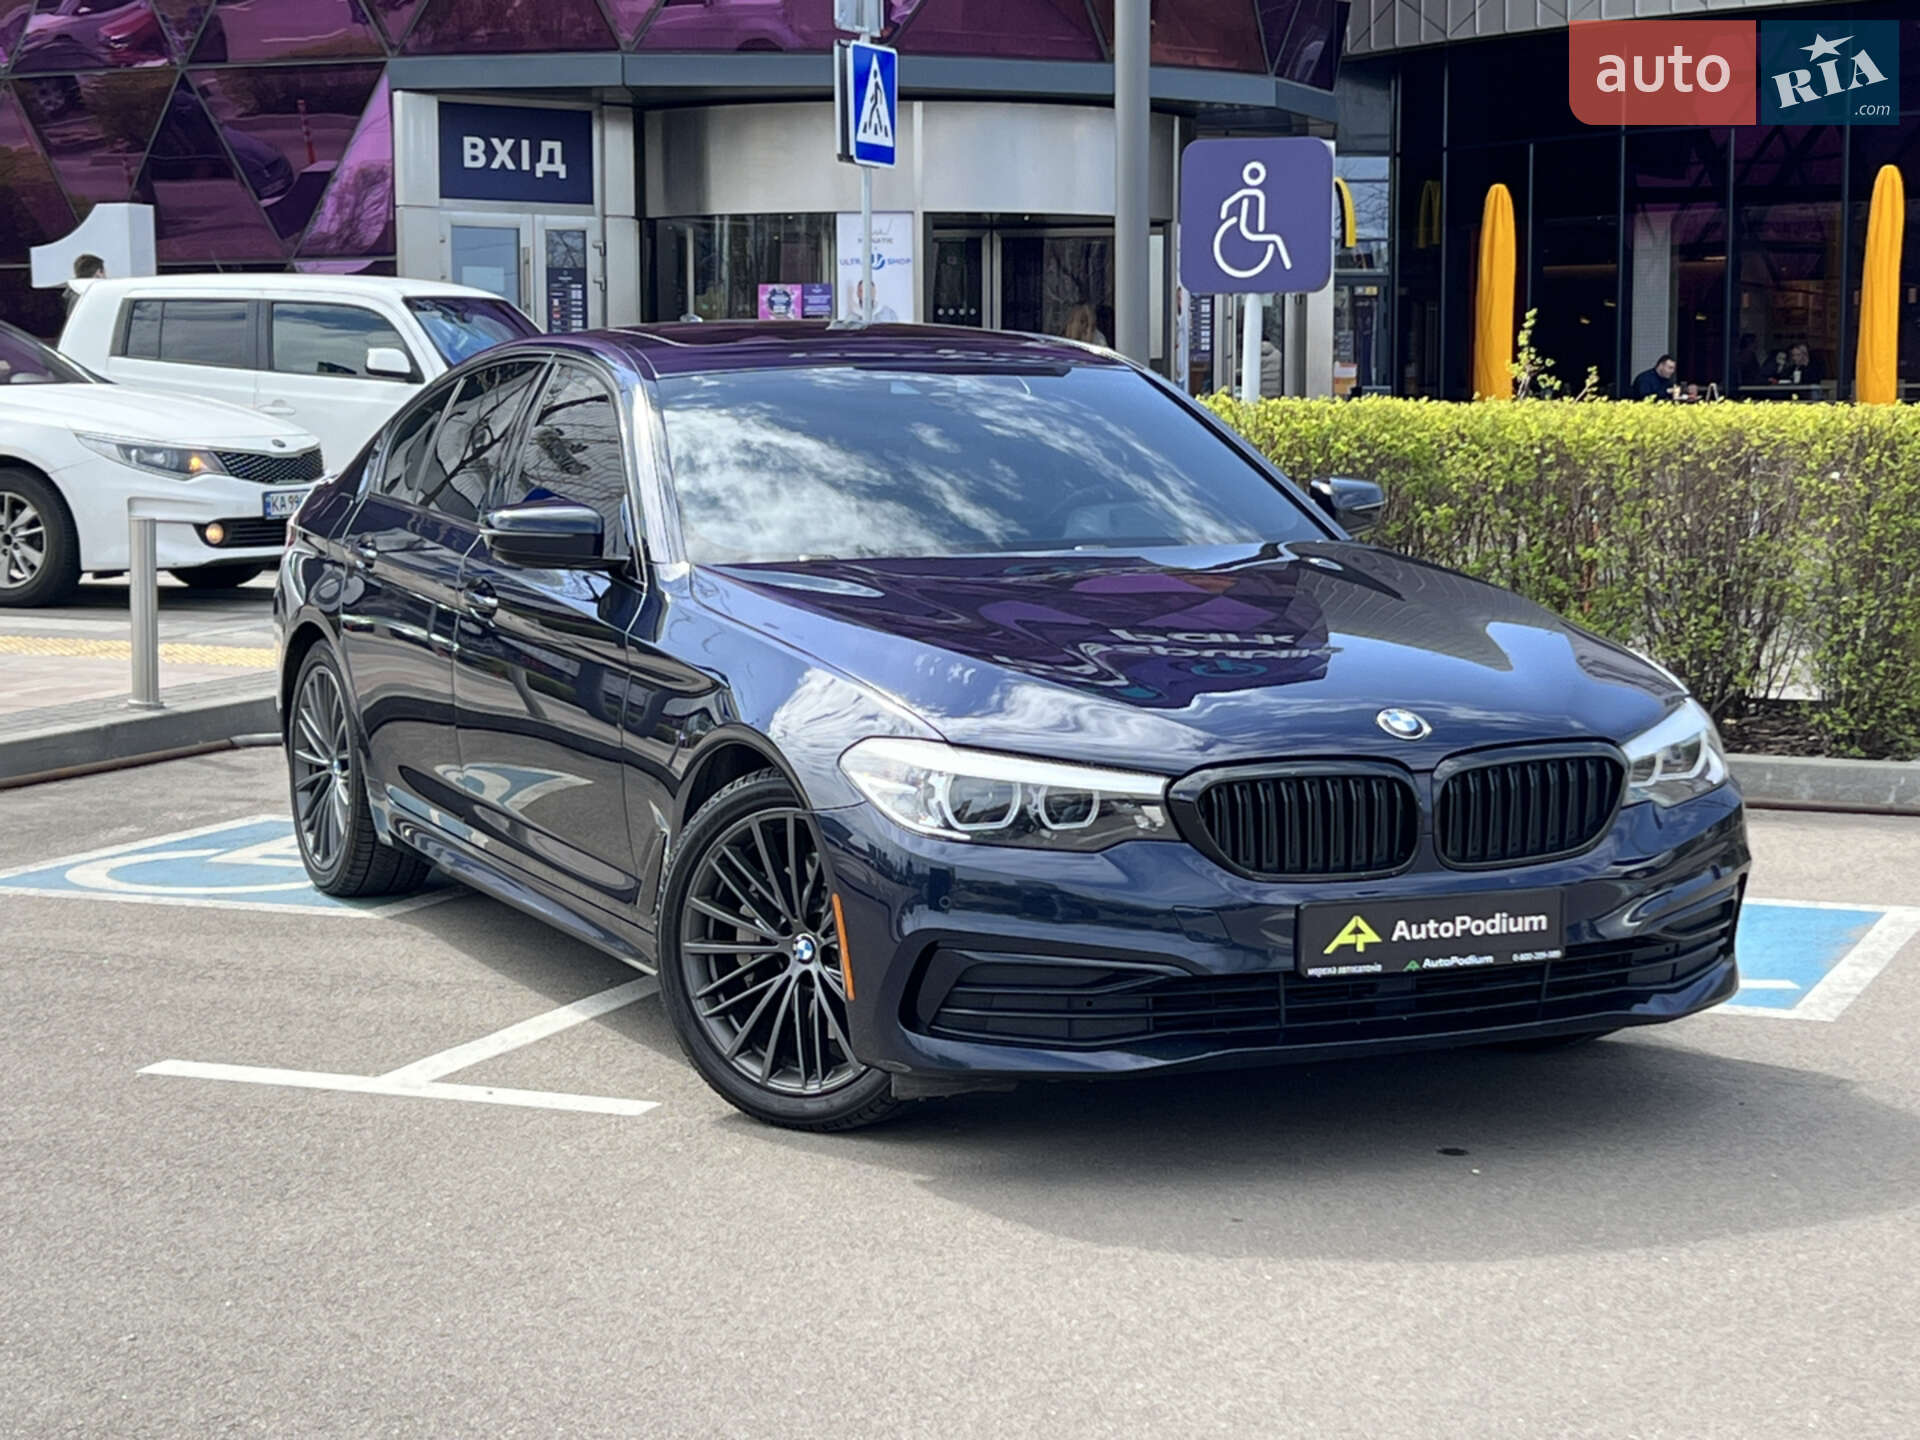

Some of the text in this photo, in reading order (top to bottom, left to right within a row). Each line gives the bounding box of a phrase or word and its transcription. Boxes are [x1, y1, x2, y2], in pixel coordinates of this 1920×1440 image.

[462, 135, 567, 179] ВХІД
[1391, 912, 1548, 942] AutoPodium
[1422, 954, 1494, 969] AutoPodium
